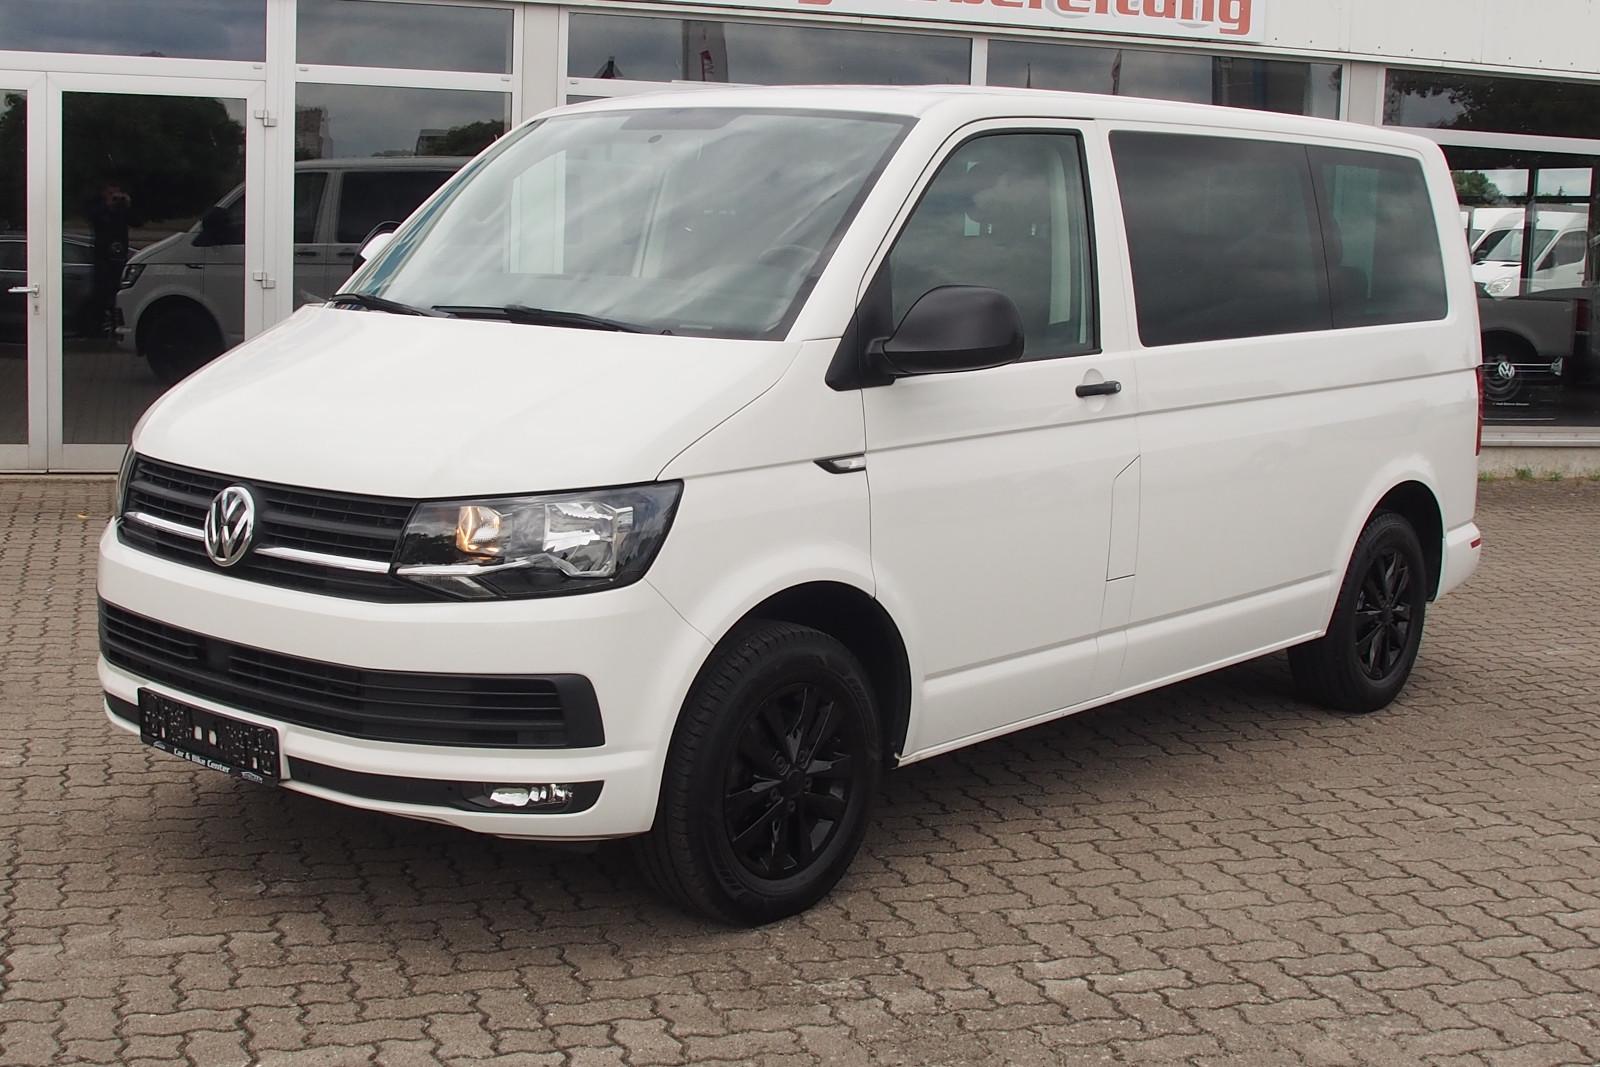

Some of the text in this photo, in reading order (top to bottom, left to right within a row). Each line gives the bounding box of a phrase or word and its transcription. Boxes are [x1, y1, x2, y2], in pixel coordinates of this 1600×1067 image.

[1498, 361, 1515, 379] VW
[204, 486, 255, 567] VW
[207, 759, 231, 774] Center
